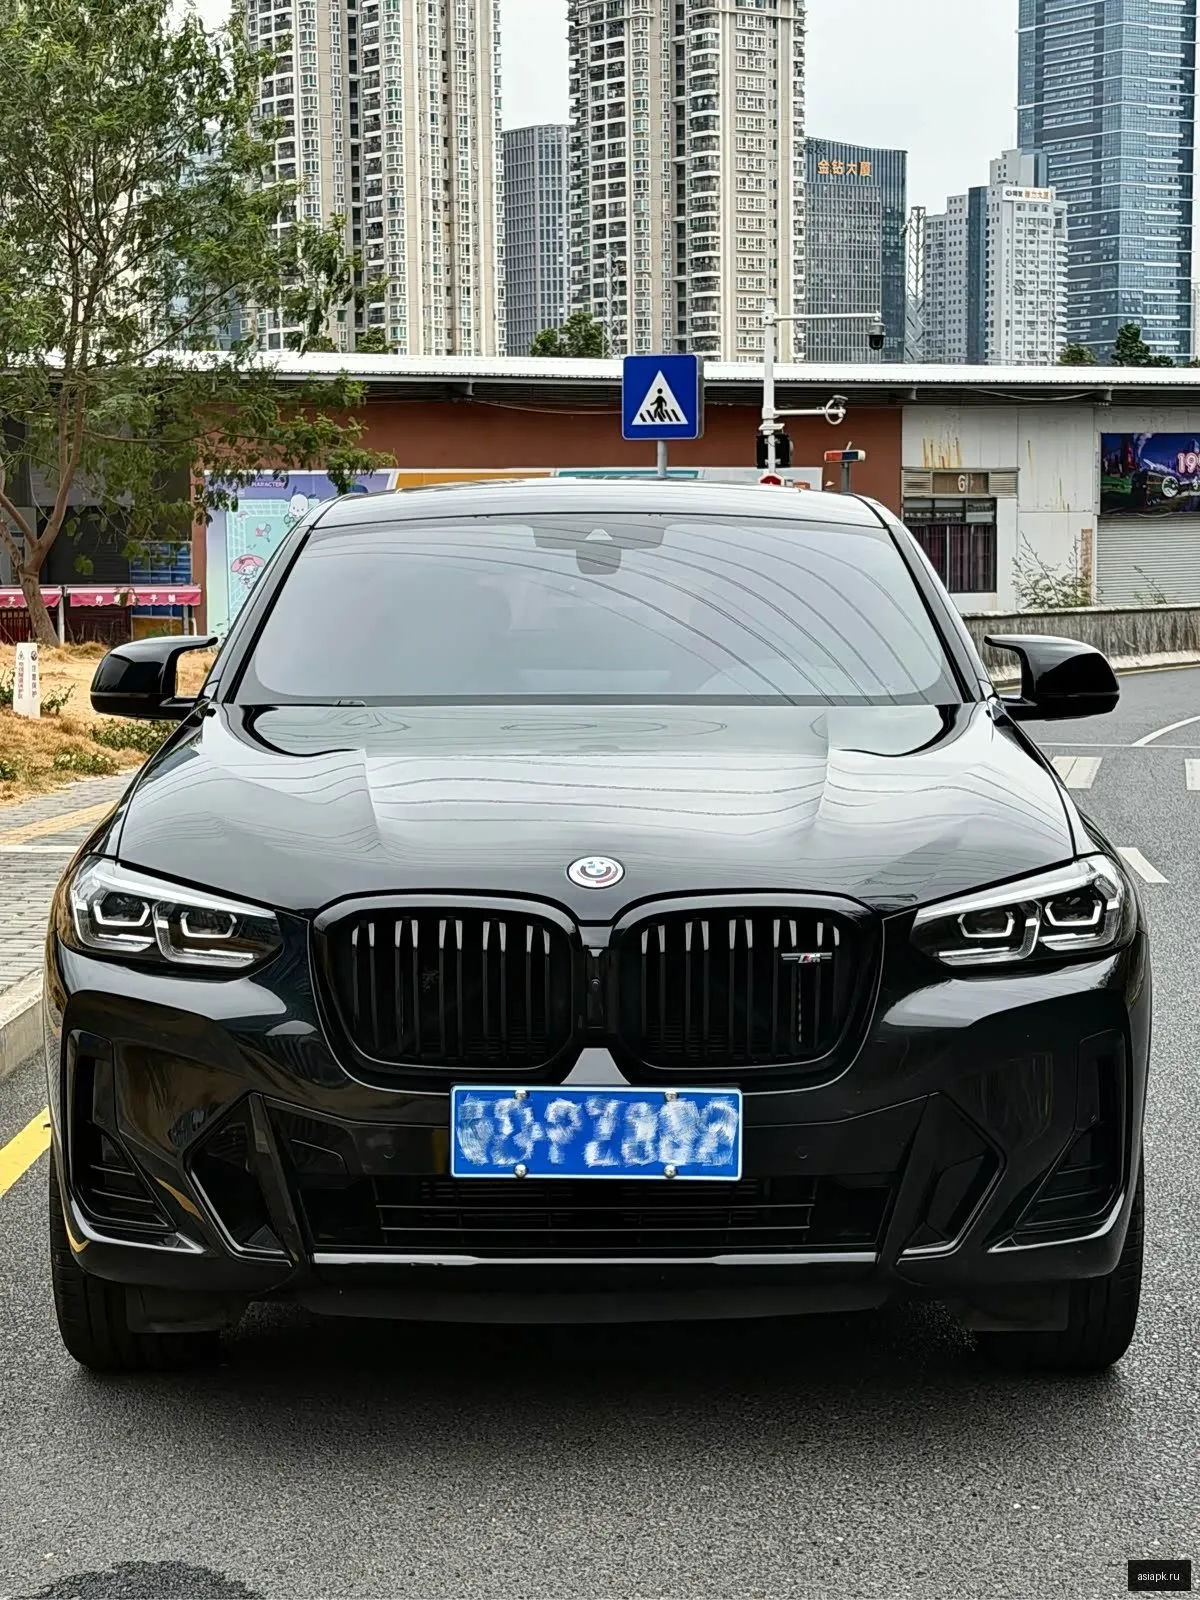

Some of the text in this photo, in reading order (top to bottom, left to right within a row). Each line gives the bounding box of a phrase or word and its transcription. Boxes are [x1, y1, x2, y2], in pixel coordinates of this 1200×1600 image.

[817, 158, 872, 177] 金钻大厦
[1177, 452, 1200, 474] 19
